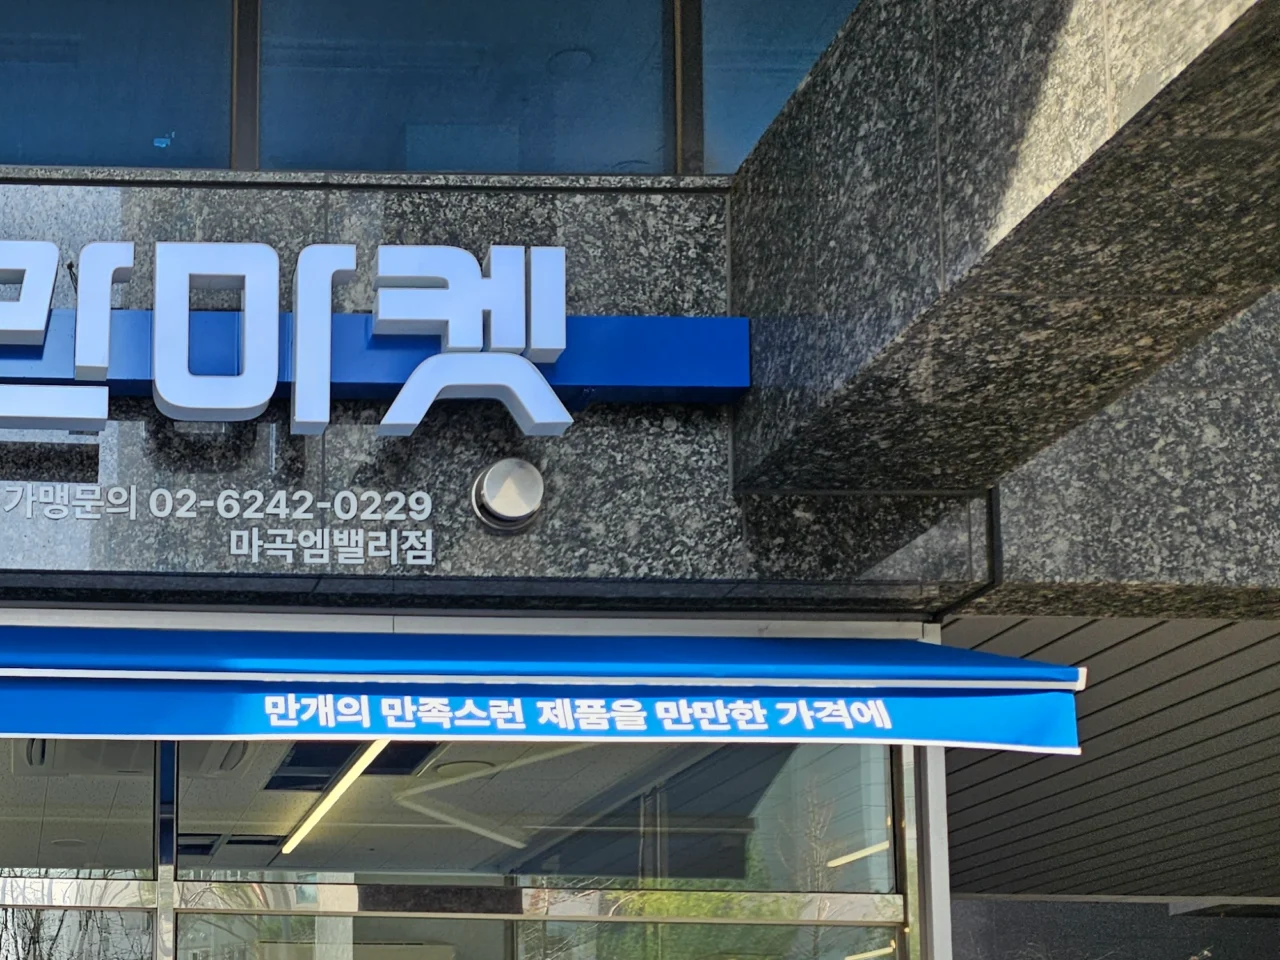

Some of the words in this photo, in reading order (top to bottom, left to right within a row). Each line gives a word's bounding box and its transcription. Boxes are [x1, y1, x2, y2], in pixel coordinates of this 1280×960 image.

[3, 484, 137, 520] 가맹문의
[149, 488, 432, 521] 02-6242-0229
[230, 527, 433, 566] 마곡엠밸리점
[265, 693, 371, 728] 만개의
[381, 696, 526, 729] 만족스런
[536, 698, 647, 730] 제품을
[656, 699, 768, 731] 만만한
[776, 700, 892, 730] 가격에
